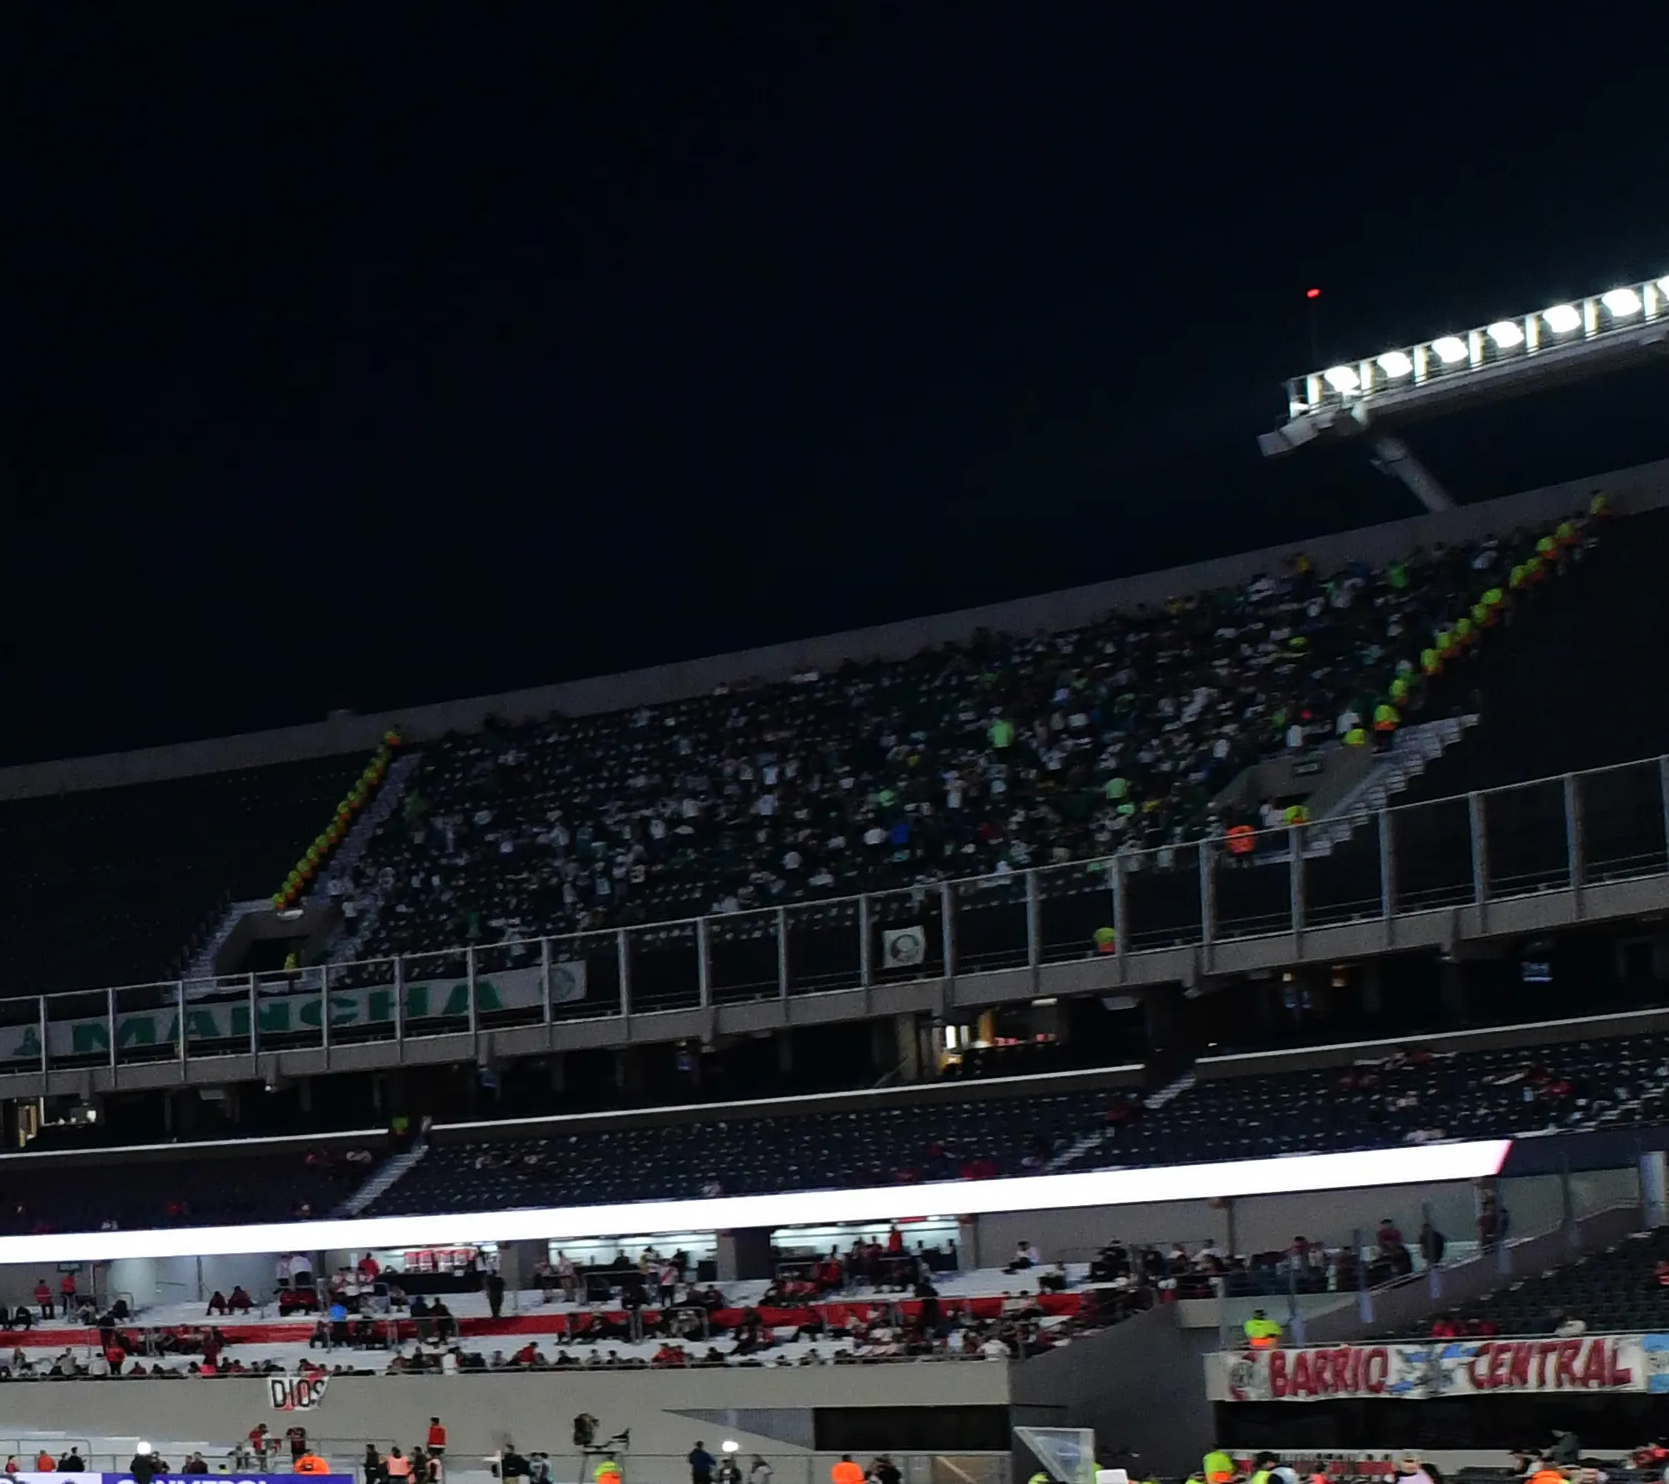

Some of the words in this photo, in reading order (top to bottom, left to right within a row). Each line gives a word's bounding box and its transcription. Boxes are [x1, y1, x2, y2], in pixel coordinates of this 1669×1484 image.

[72, 980, 503, 1053] MANCHA
[1269, 1345, 1389, 1398] BARRIO
[1468, 1337, 1633, 1390] CENTRAL
